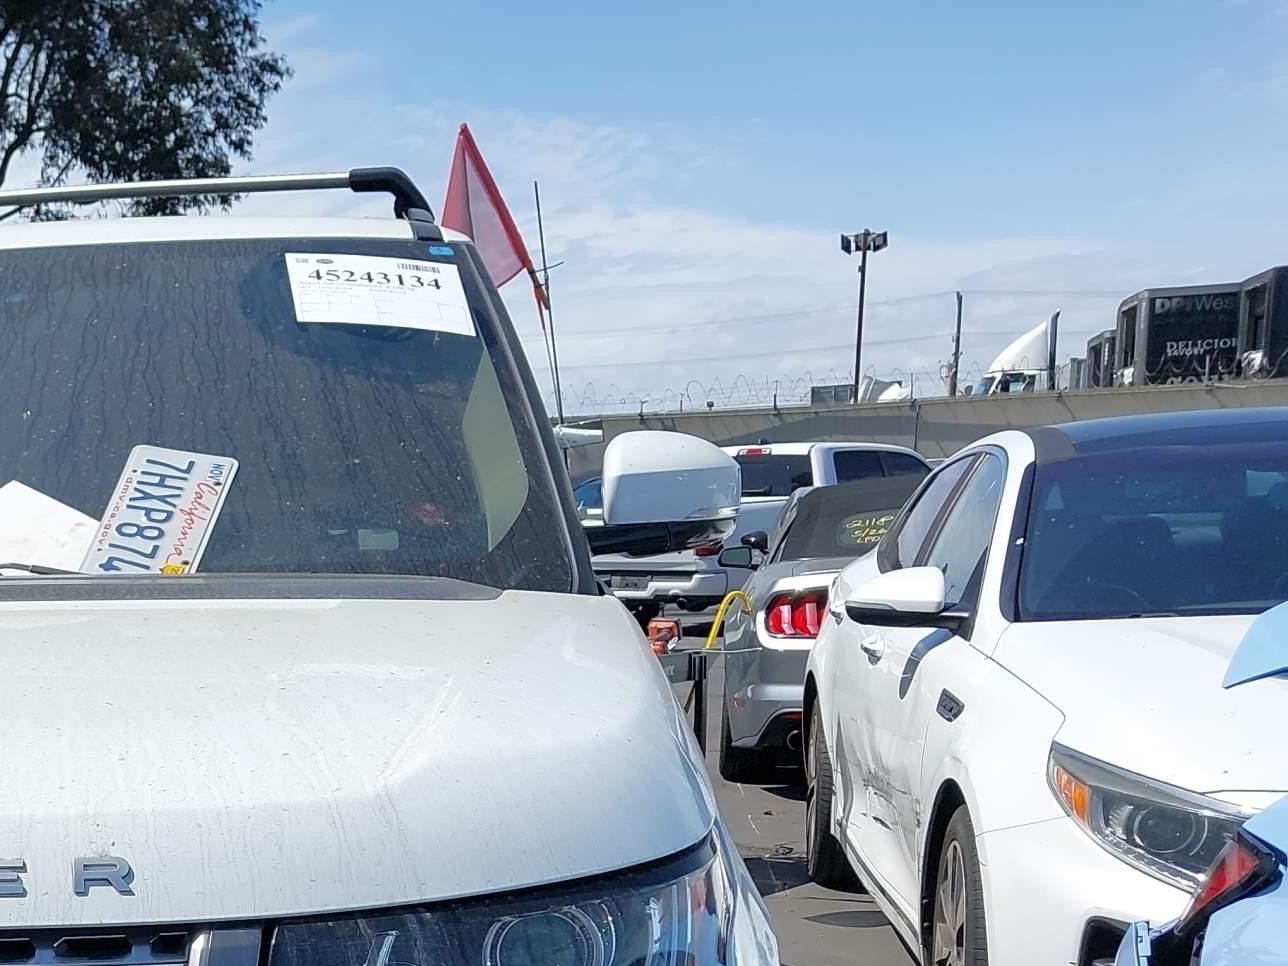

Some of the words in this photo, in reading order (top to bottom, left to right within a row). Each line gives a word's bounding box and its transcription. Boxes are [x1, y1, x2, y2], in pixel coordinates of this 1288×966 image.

[308, 268, 442, 291] 45243134
[208, 463, 227, 482] NOV
[98, 458, 196, 571] 7HXP874
[165, 480, 219, 564] California
